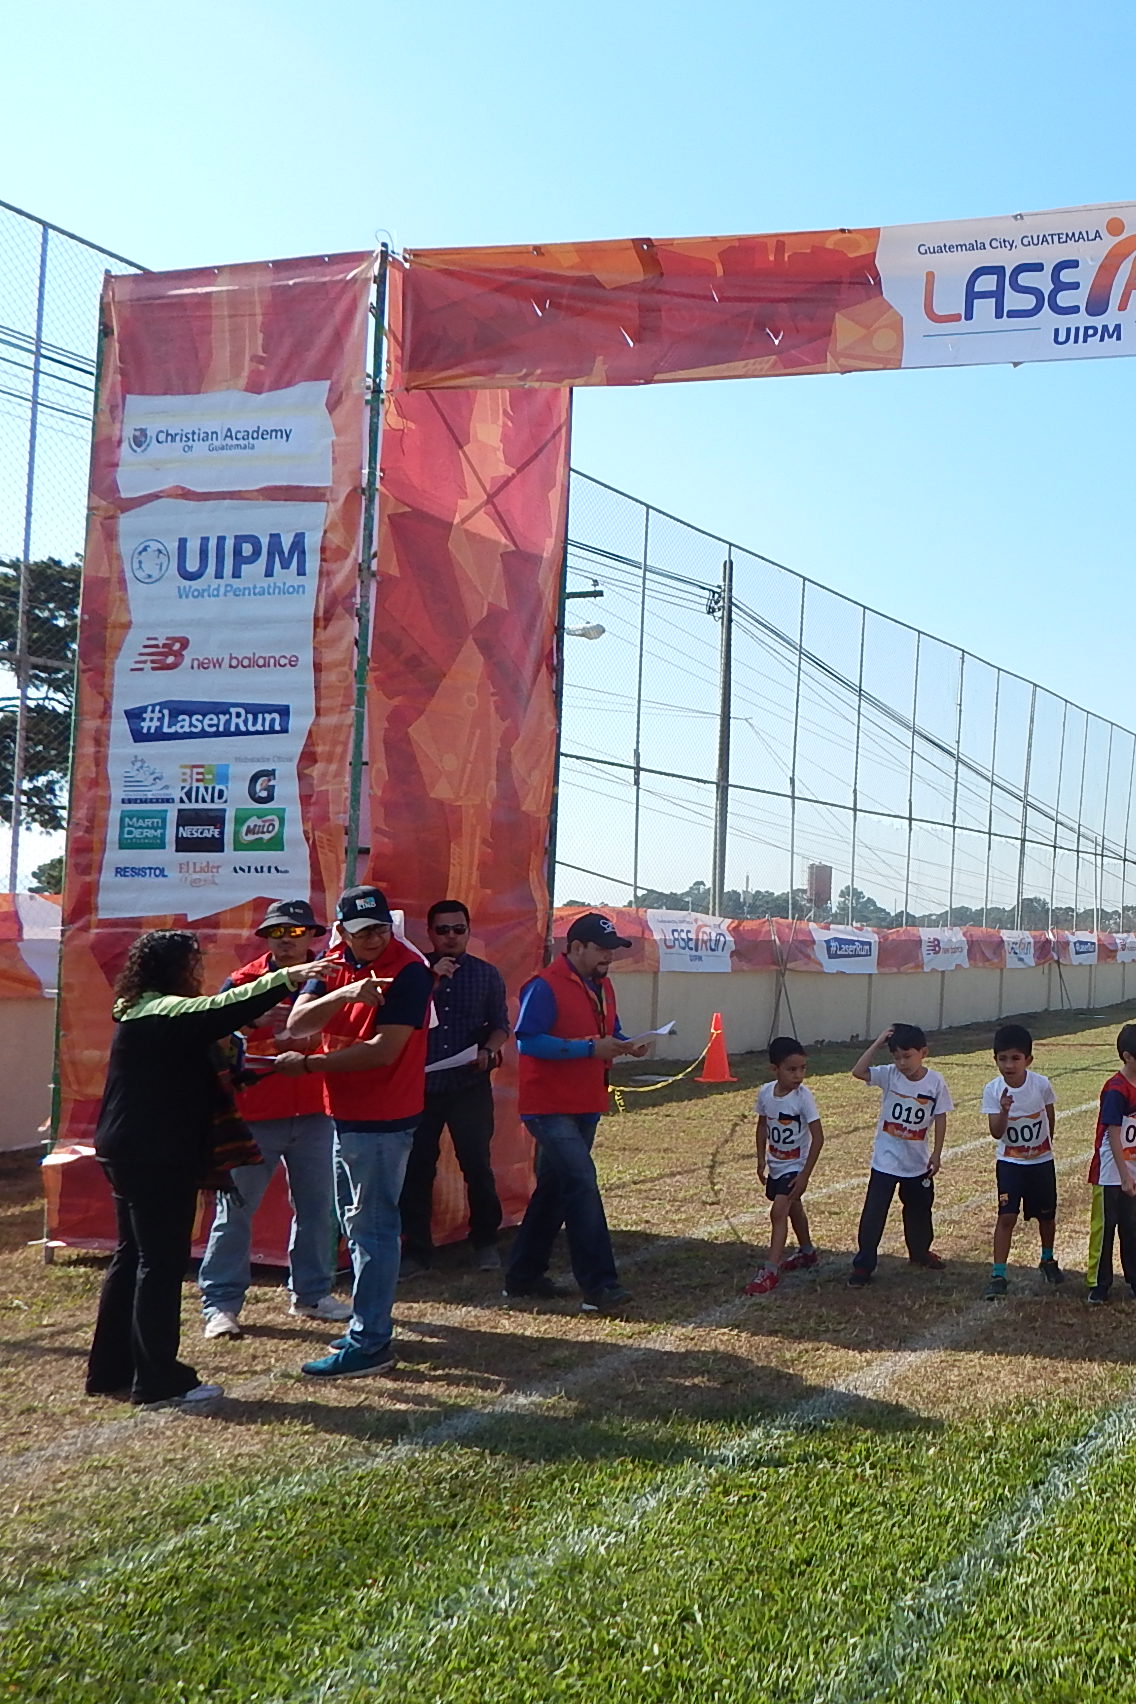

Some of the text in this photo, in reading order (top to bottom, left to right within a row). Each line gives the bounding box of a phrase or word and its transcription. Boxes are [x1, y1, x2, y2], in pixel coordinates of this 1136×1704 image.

[918, 229, 1104, 256] Guatemala City, GUATEMALA
[1052, 322, 1122, 346] UIPM
[155, 426, 293, 445] Christian Academy
[182, 441, 256, 454] Of Guatemala
[176, 531, 307, 582] UIPM
[176, 581, 306, 600] World Pentathlon
[190, 652, 299, 670] new balance
[140, 705, 281, 734] #LaserRun
[178, 785, 228, 804] KIND
[124, 816, 162, 828] MARTI
[244, 822, 276, 837] MILO
[114, 866, 168, 878] RESISTOL
[178, 861, 190, 874] El
[830, 940, 871, 956] #LaserRun
[892, 1102, 925, 1124] 019
[1006, 1120, 1043, 1144] 007
